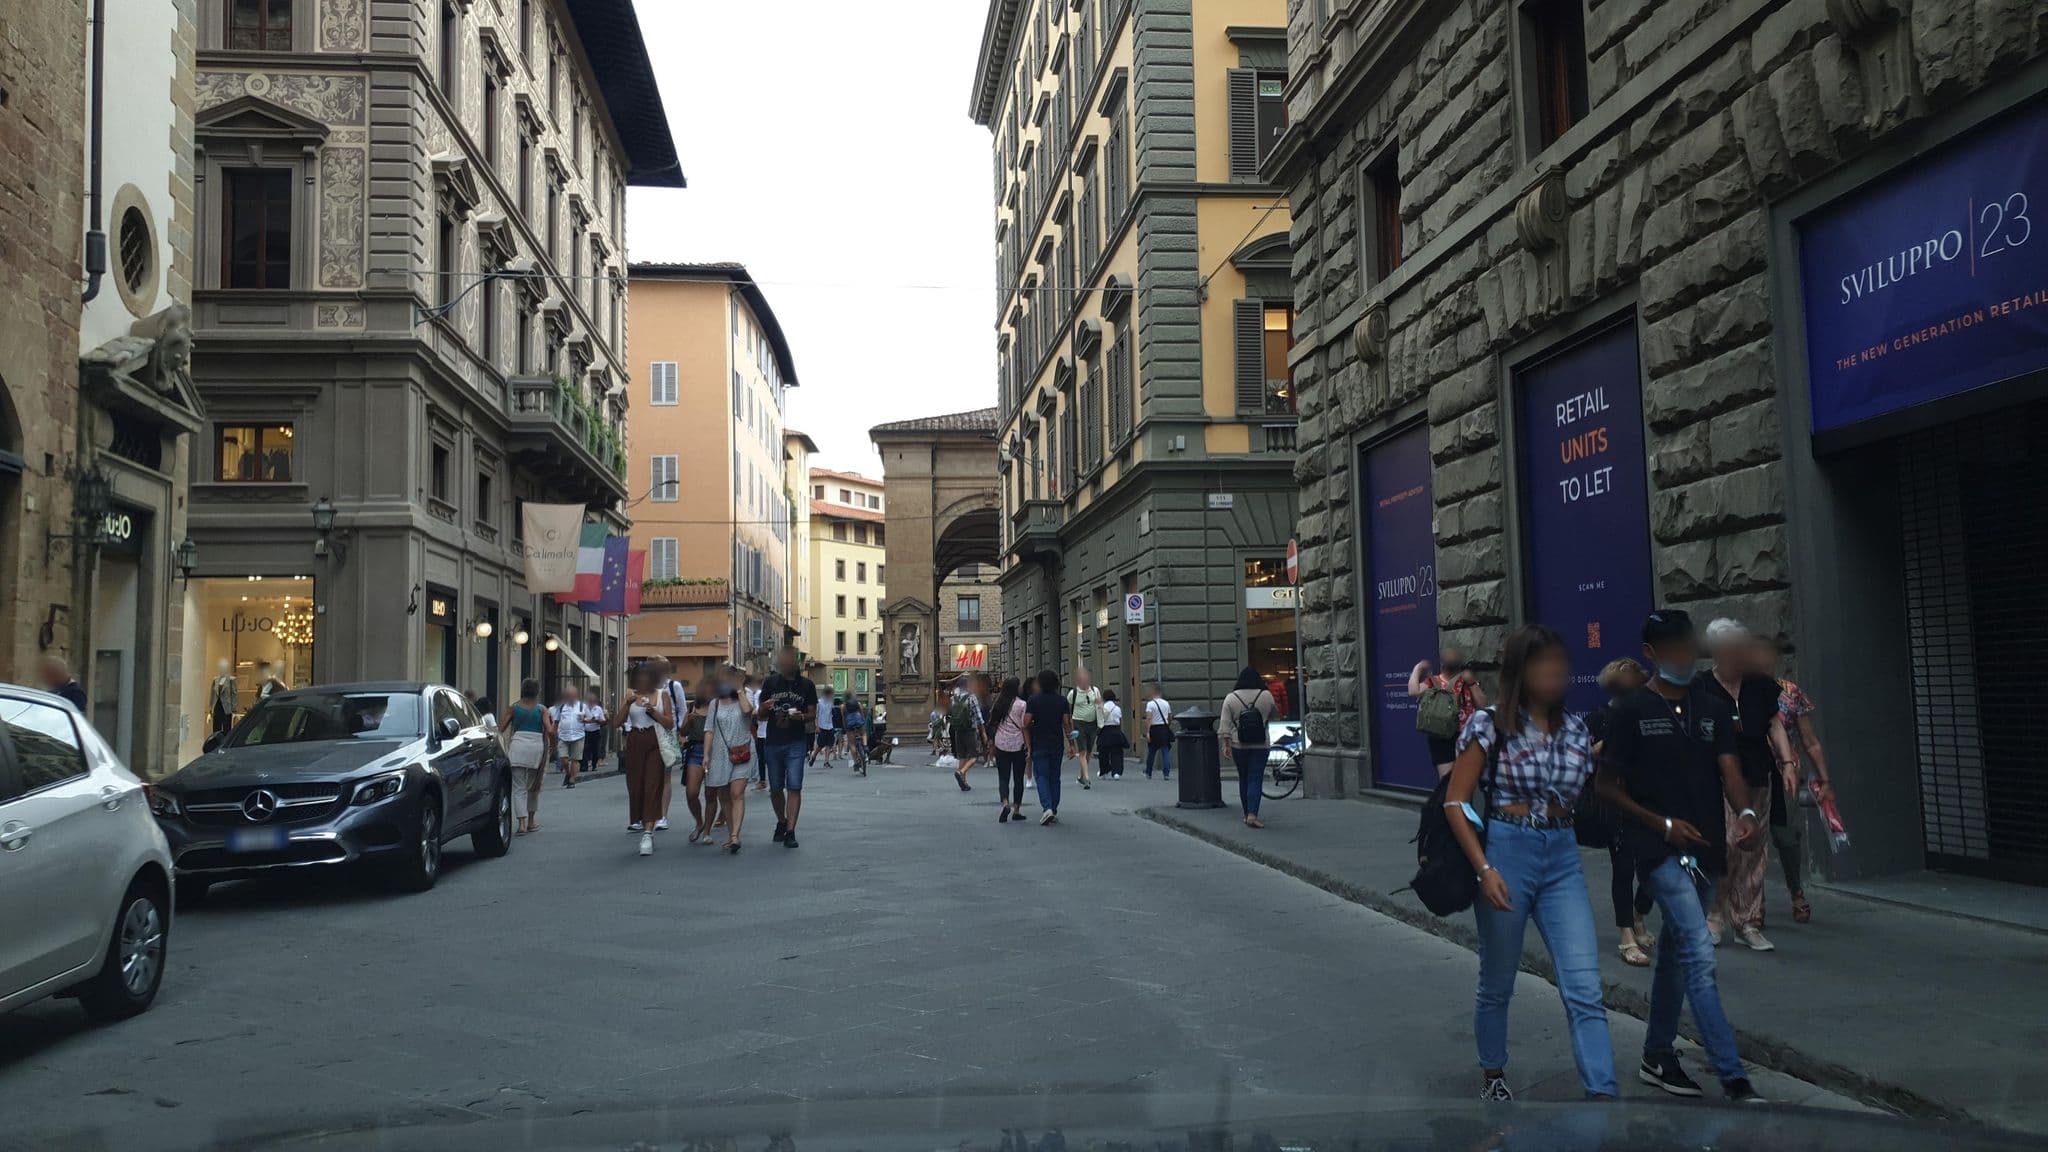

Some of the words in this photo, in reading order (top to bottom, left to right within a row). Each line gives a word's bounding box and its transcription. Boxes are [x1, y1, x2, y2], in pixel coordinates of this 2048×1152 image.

[1840, 230, 1962, 305] SVILUPPO
[1980, 192, 2031, 257] 23
[1836, 353, 1857, 371] THE
[1861, 342, 1888, 362] NEW
[1894, 309, 1984, 351] GENERATION
[1989, 288, 2048, 318] RETAIL
[1556, 386, 1610, 428] RETAIL
[1561, 427, 1608, 464] UNITS
[1559, 477, 1580, 504] TO
[1585, 466, 1613, 498] LET
[1378, 575, 1416, 600] SVILUPPO
[1420, 565, 1434, 597] 23
